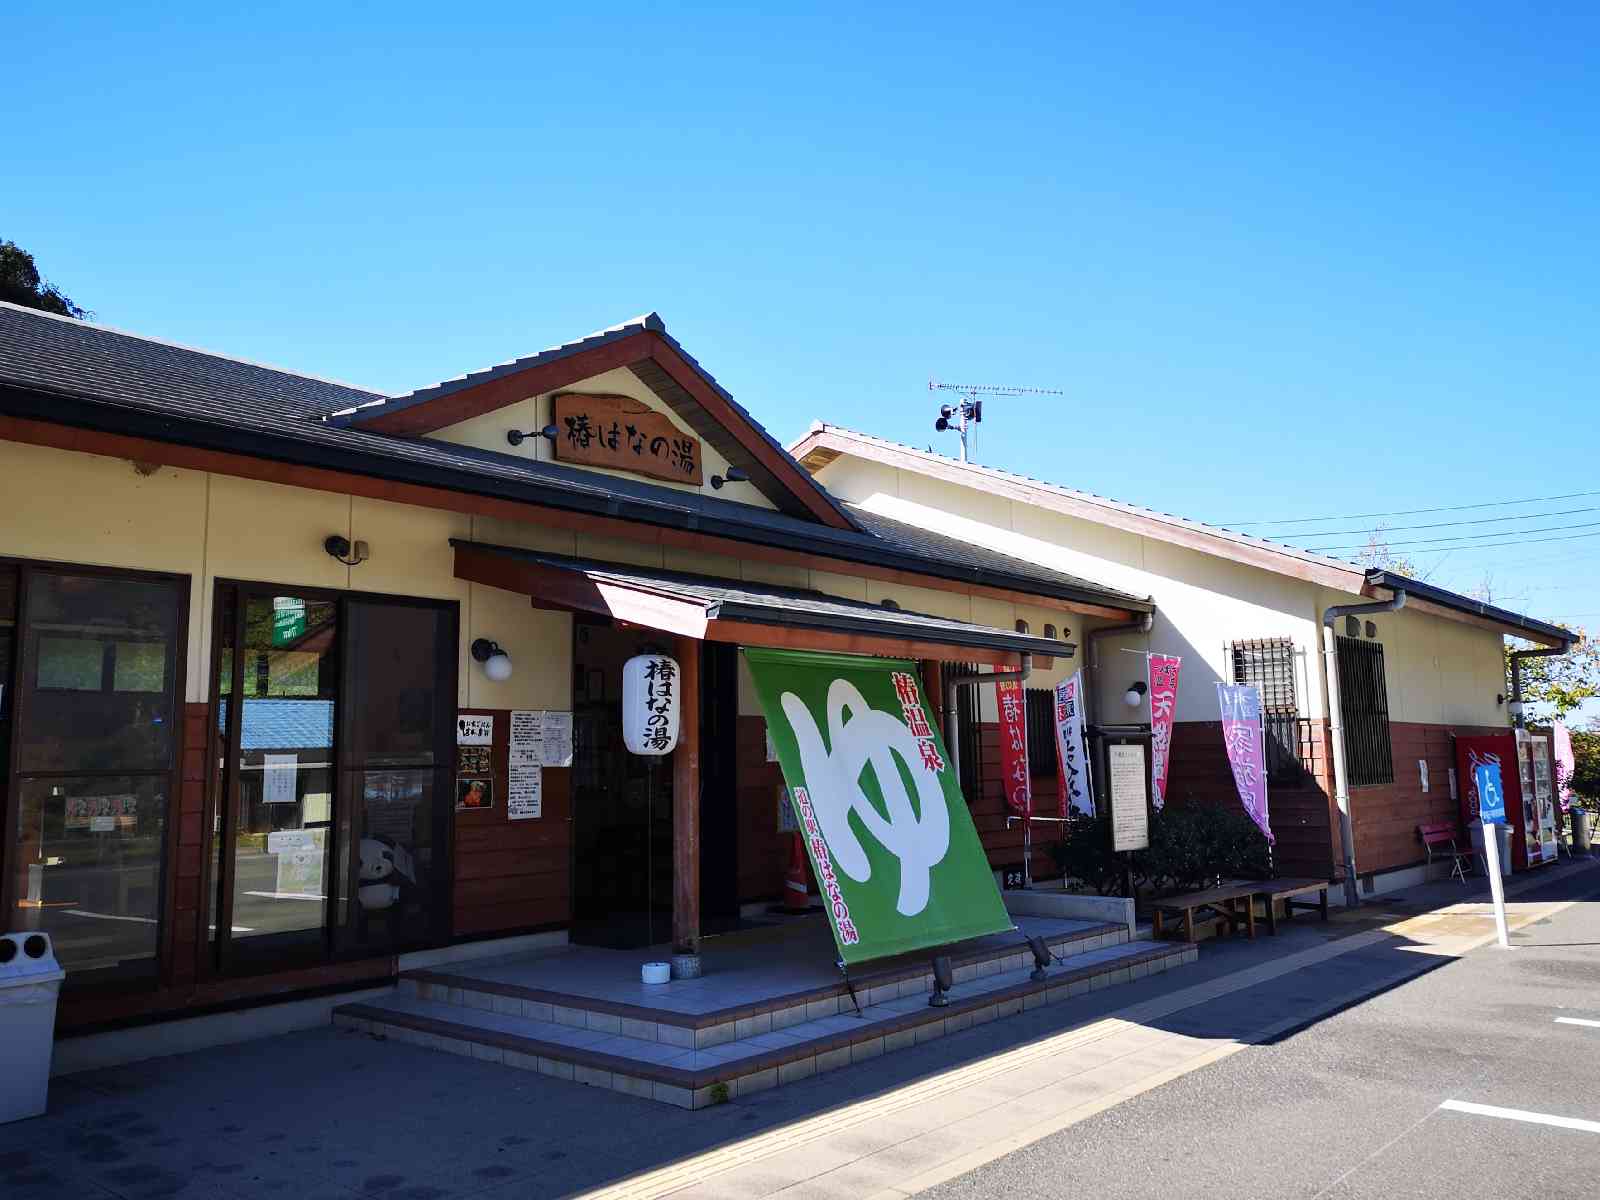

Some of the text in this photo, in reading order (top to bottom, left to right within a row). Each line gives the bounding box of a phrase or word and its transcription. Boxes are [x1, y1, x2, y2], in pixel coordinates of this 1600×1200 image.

[564, 413, 695, 476] 椿はなの湯
[643, 659, 676, 751] 椿はなの湯
[780, 678, 950, 917] ゆ
[809, 835, 859, 945] 椿はなの湯
